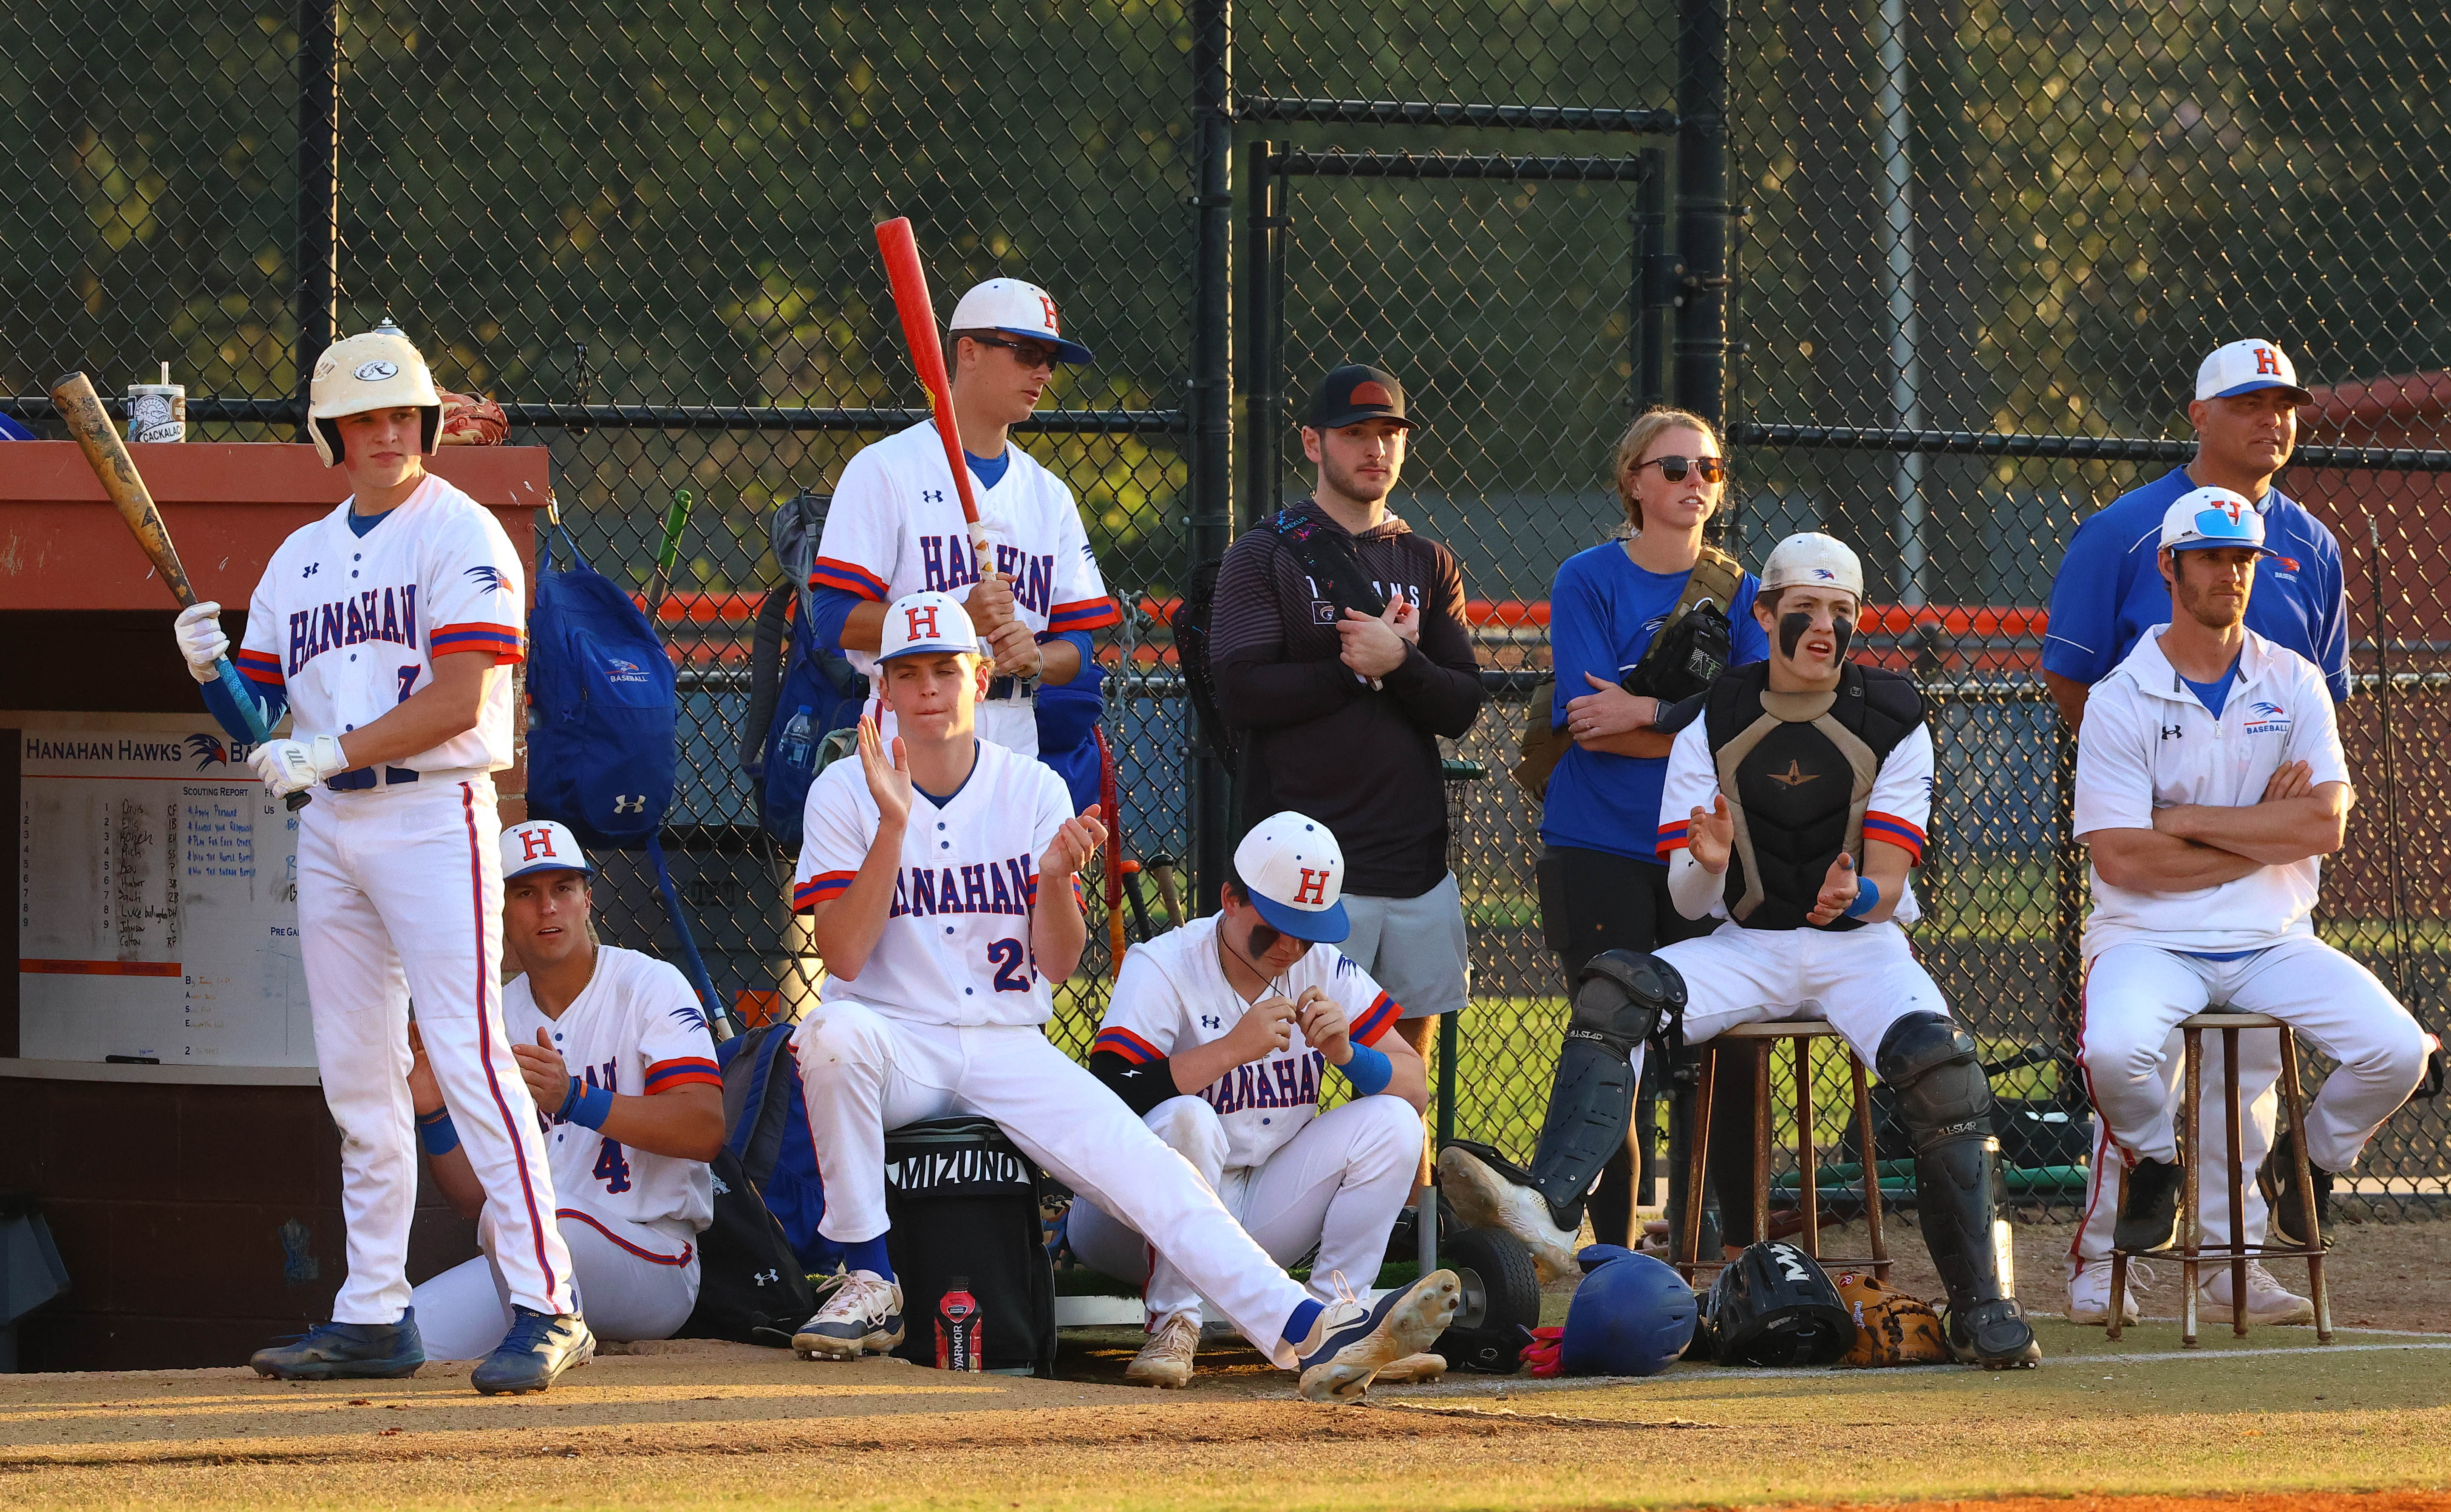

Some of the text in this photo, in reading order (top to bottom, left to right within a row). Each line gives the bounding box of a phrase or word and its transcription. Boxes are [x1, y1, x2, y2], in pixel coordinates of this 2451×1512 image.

[1039, 296, 1061, 334] H
[2254, 348, 2281, 375] H
[1282, 516, 1308, 531] NEXUS
[905, 606, 940, 642] H
[289, 584, 417, 679] HANAHAN
[398, 664, 421, 705] 7
[27, 738, 113, 760] HANAHAN
[119, 740, 181, 762] HAWKS
[183, 787, 249, 797] SCOUTING REPORT
[105, 803, 108, 811] 1
[168, 804, 177, 816] CF
[264, 805, 275, 814] US
[104, 817, 109, 826] 2
[104, 832, 109, 841] 3
[519, 828, 556, 862] H
[104, 847, 109, 855] 4
[104, 862, 109, 870] 5
[104, 876, 109, 885] 6
[889, 853, 1030, 919] ANAHAN
[1293, 868, 1330, 904] H
[104, 891, 108, 899] 7
[167, 892, 178, 904] 2B
[104, 905, 108, 914] 8
[167, 907, 177, 918] DH
[104, 920, 108, 929] 9
[170, 923, 175, 933] C
[271, 927, 285, 936] PRE
[185, 1046, 190, 1055] 2
[592, 1136, 631, 1194] 4
[899, 1150, 1019, 1190] MIZUNO
